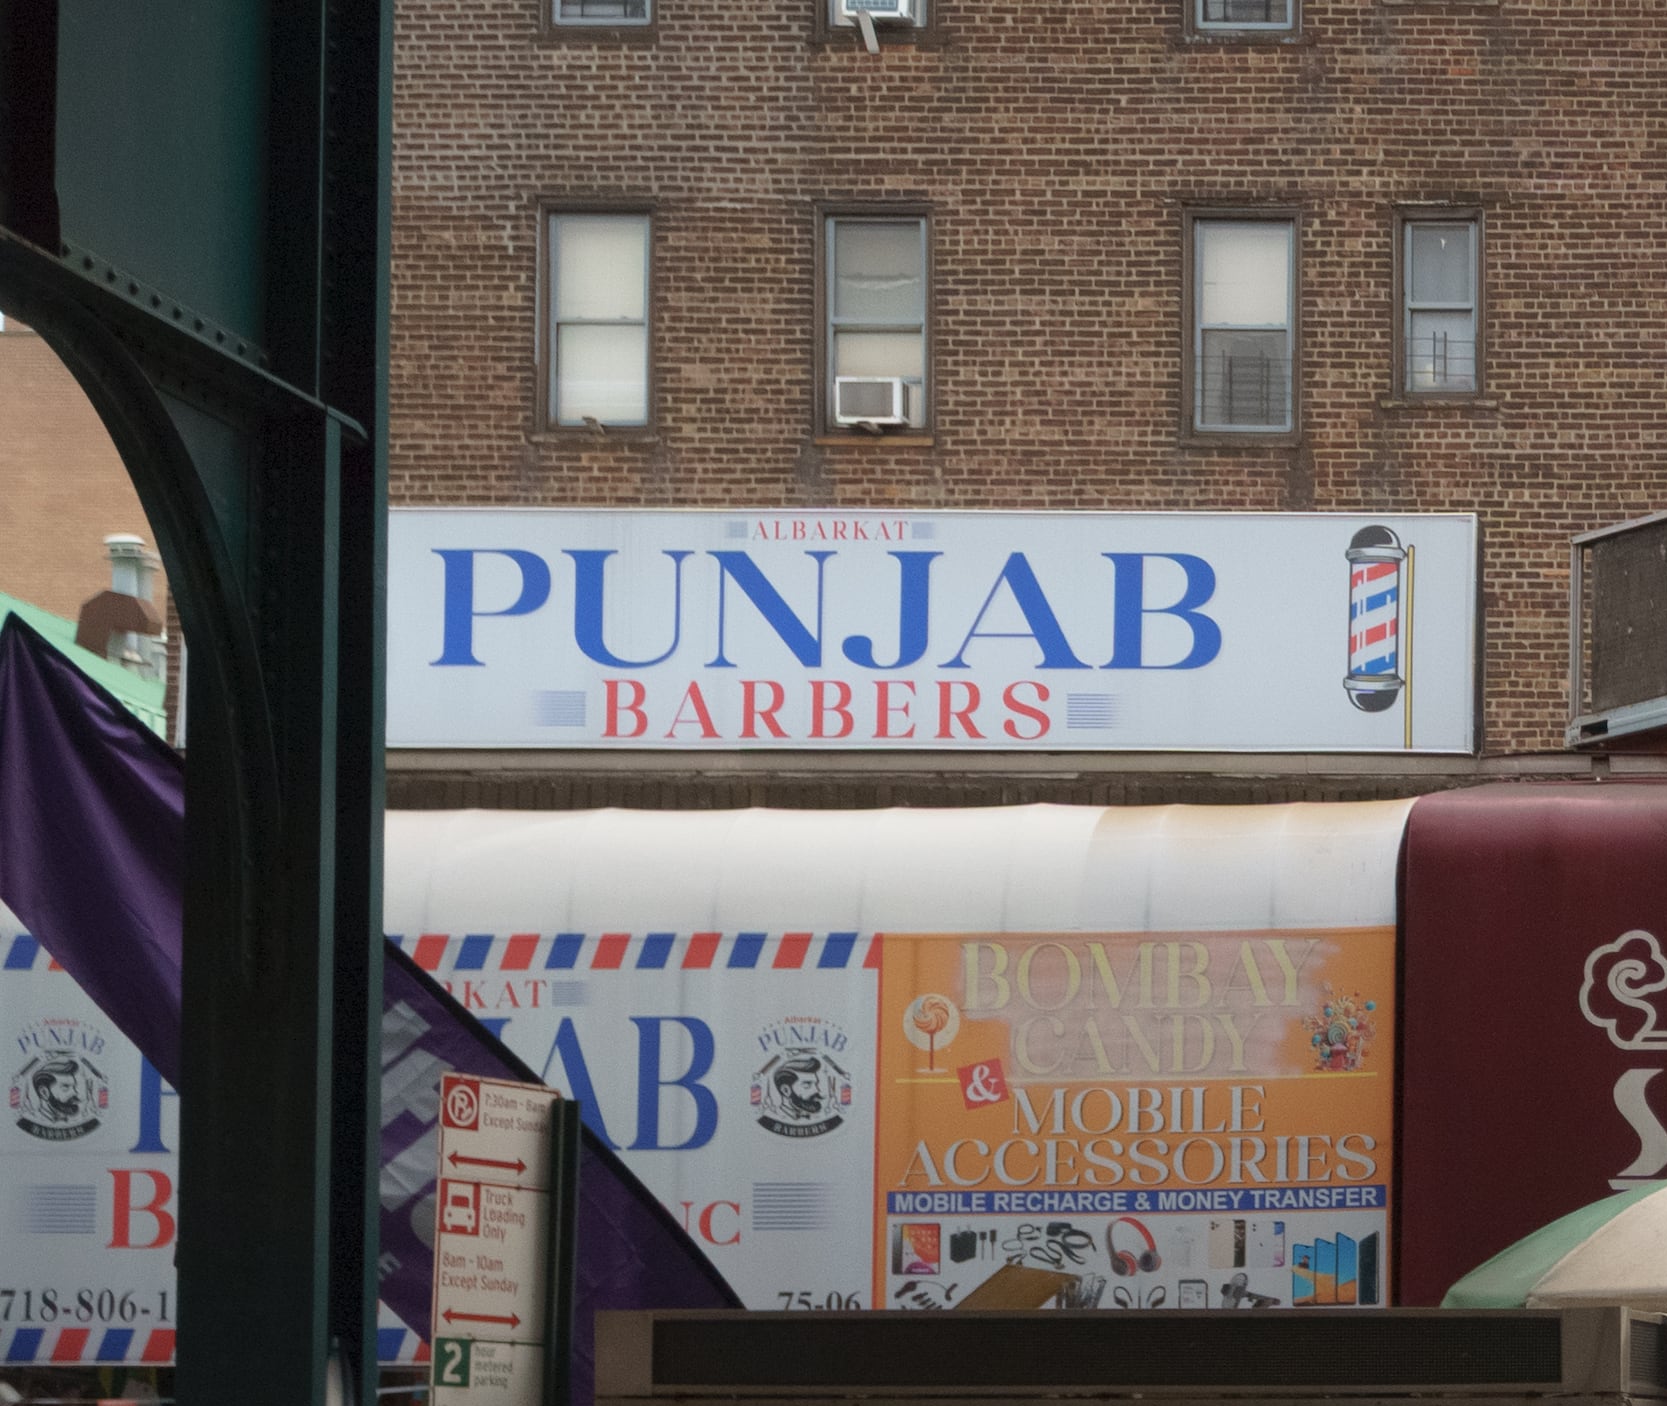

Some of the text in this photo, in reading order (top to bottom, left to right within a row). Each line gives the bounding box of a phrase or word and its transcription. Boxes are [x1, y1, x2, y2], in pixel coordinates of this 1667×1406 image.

[752, 520, 911, 541] ALBARKAT
[429, 548, 1223, 671] PUNJAB
[600, 679, 1053, 741] BARBERS
[960, 939, 1321, 1012] BOMBAY
[16, 1026, 107, 1056] PUNJAB
[757, 1025, 849, 1053] PUNJAB
[1014, 1012, 1261, 1076] CANDY
[964, 1064, 1002, 1103] &
[482, 1111, 515, 1131] Except
[1011, 1085, 1268, 1136] MOBILE
[897, 1133, 1379, 1187] ACCESSORIES
[484, 1188, 514, 1208] Truck
[894, 1187, 1379, 1214] MOBILE RECHARGE & MONEY TRANSFER
[482, 1206, 526, 1228] Loading
[482, 1223, 508, 1243] Only
[475, 1255, 504, 1272] 10am
[442, 1272, 519, 1296] Except Sunday
[441, 1341, 463, 1384] 2
